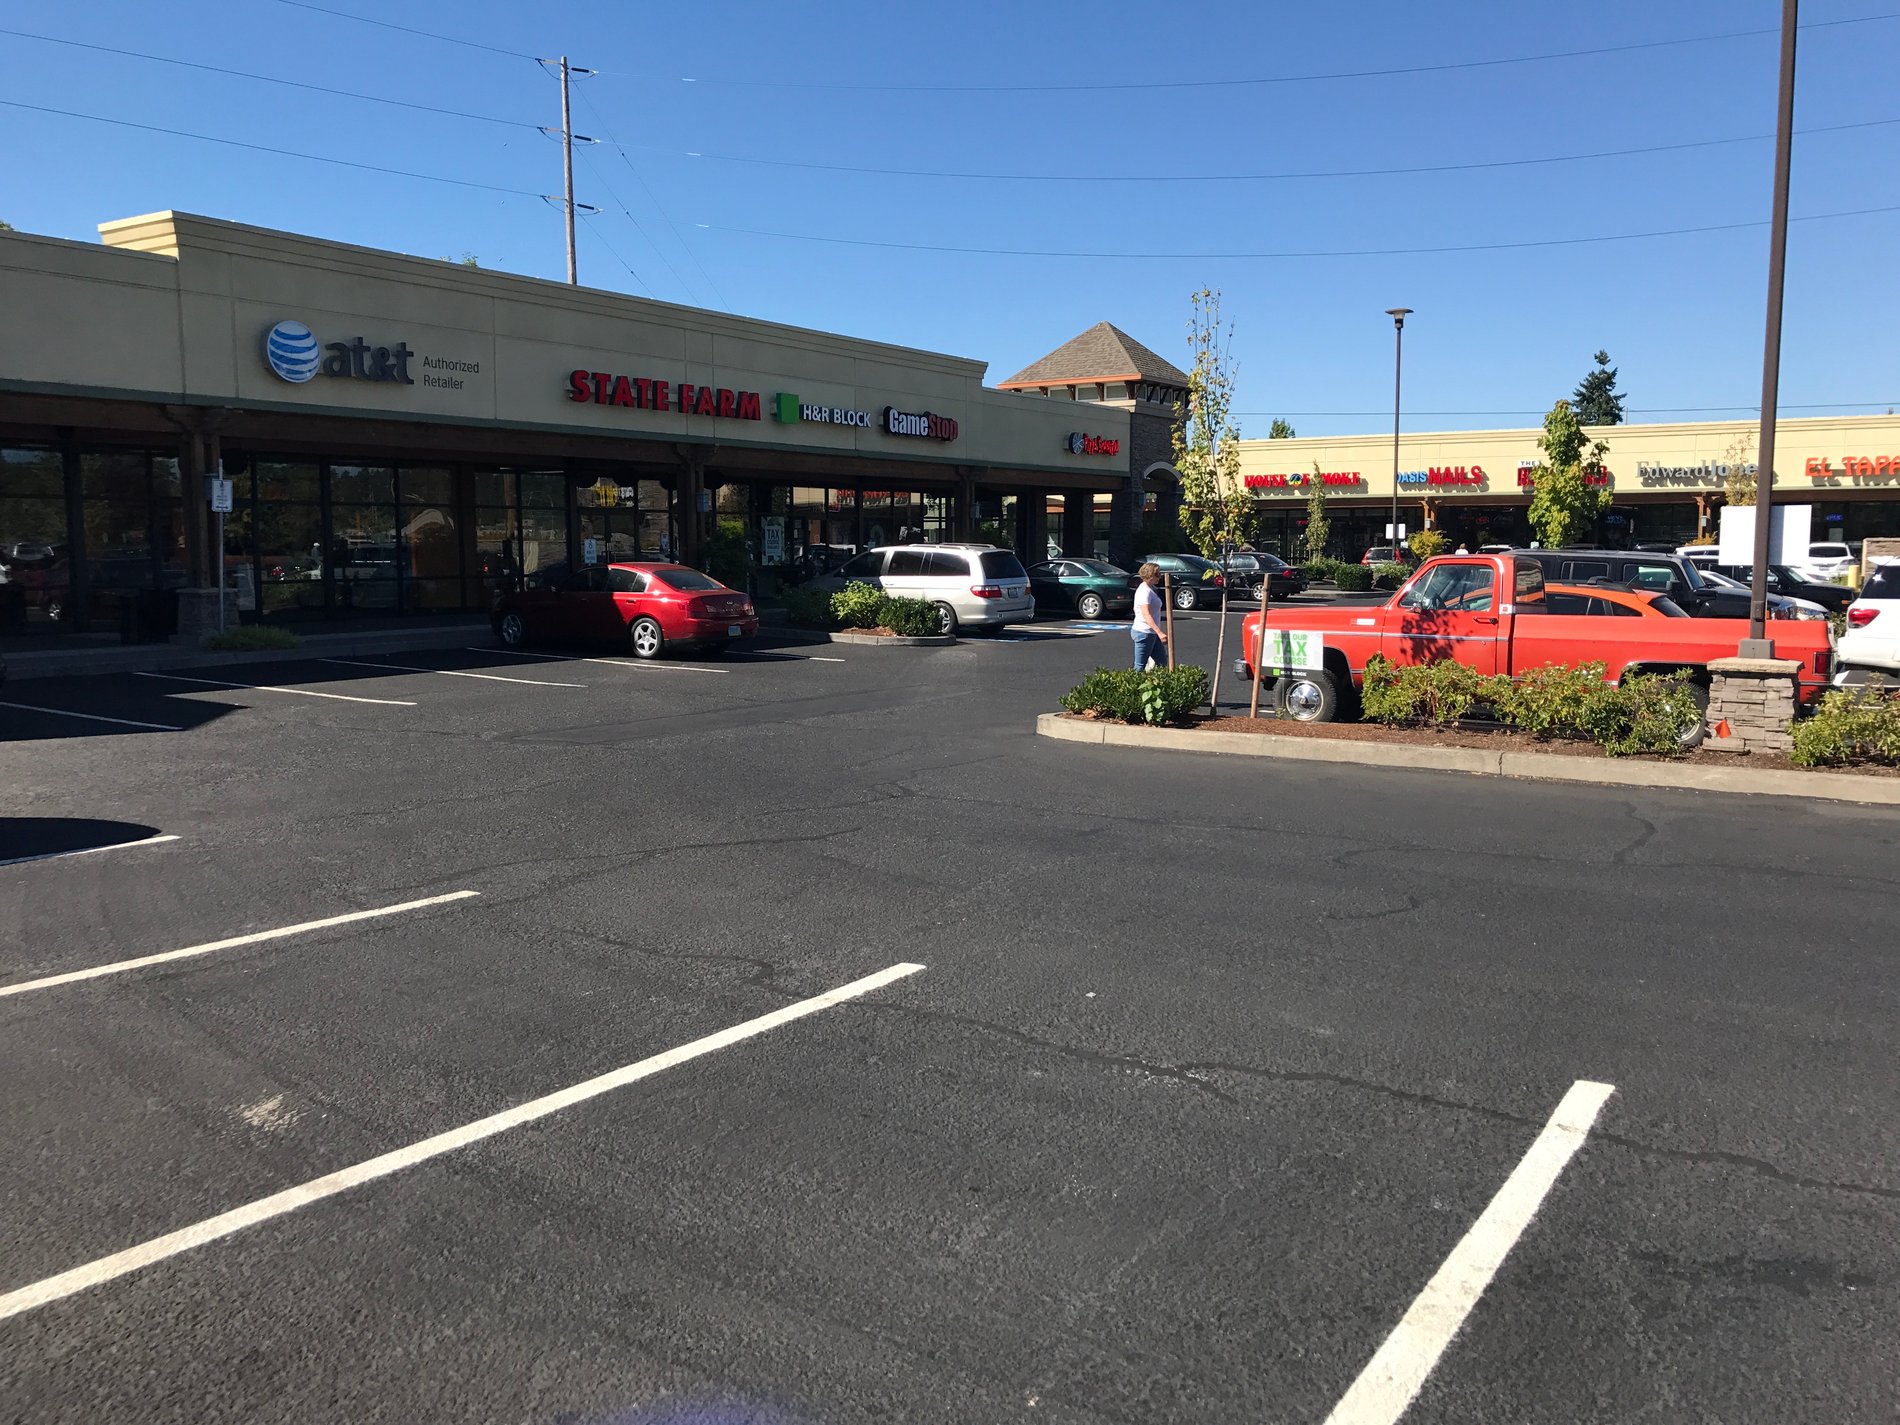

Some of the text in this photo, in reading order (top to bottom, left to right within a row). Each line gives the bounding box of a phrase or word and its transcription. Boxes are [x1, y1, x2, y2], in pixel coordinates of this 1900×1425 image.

[323, 337, 414, 385] at&t
[423, 356, 480, 373] Authorized
[424, 375, 464, 390] Retailer
[569, 369, 761, 420] STATE FARM
[803, 405, 871, 428] H&R BLOCK
[889, 409, 958, 442] GameStop
[1428, 466, 1483, 485] NAILS
[1635, 460, 1706, 478] Edward
[1805, 457, 1832, 477] EL
[1244, 474, 1287, 488] HOUSE
[1321, 472, 1360, 485] MOKE
[1273, 640, 1307, 656] TAX
[1273, 656, 1307, 665] COURSE
